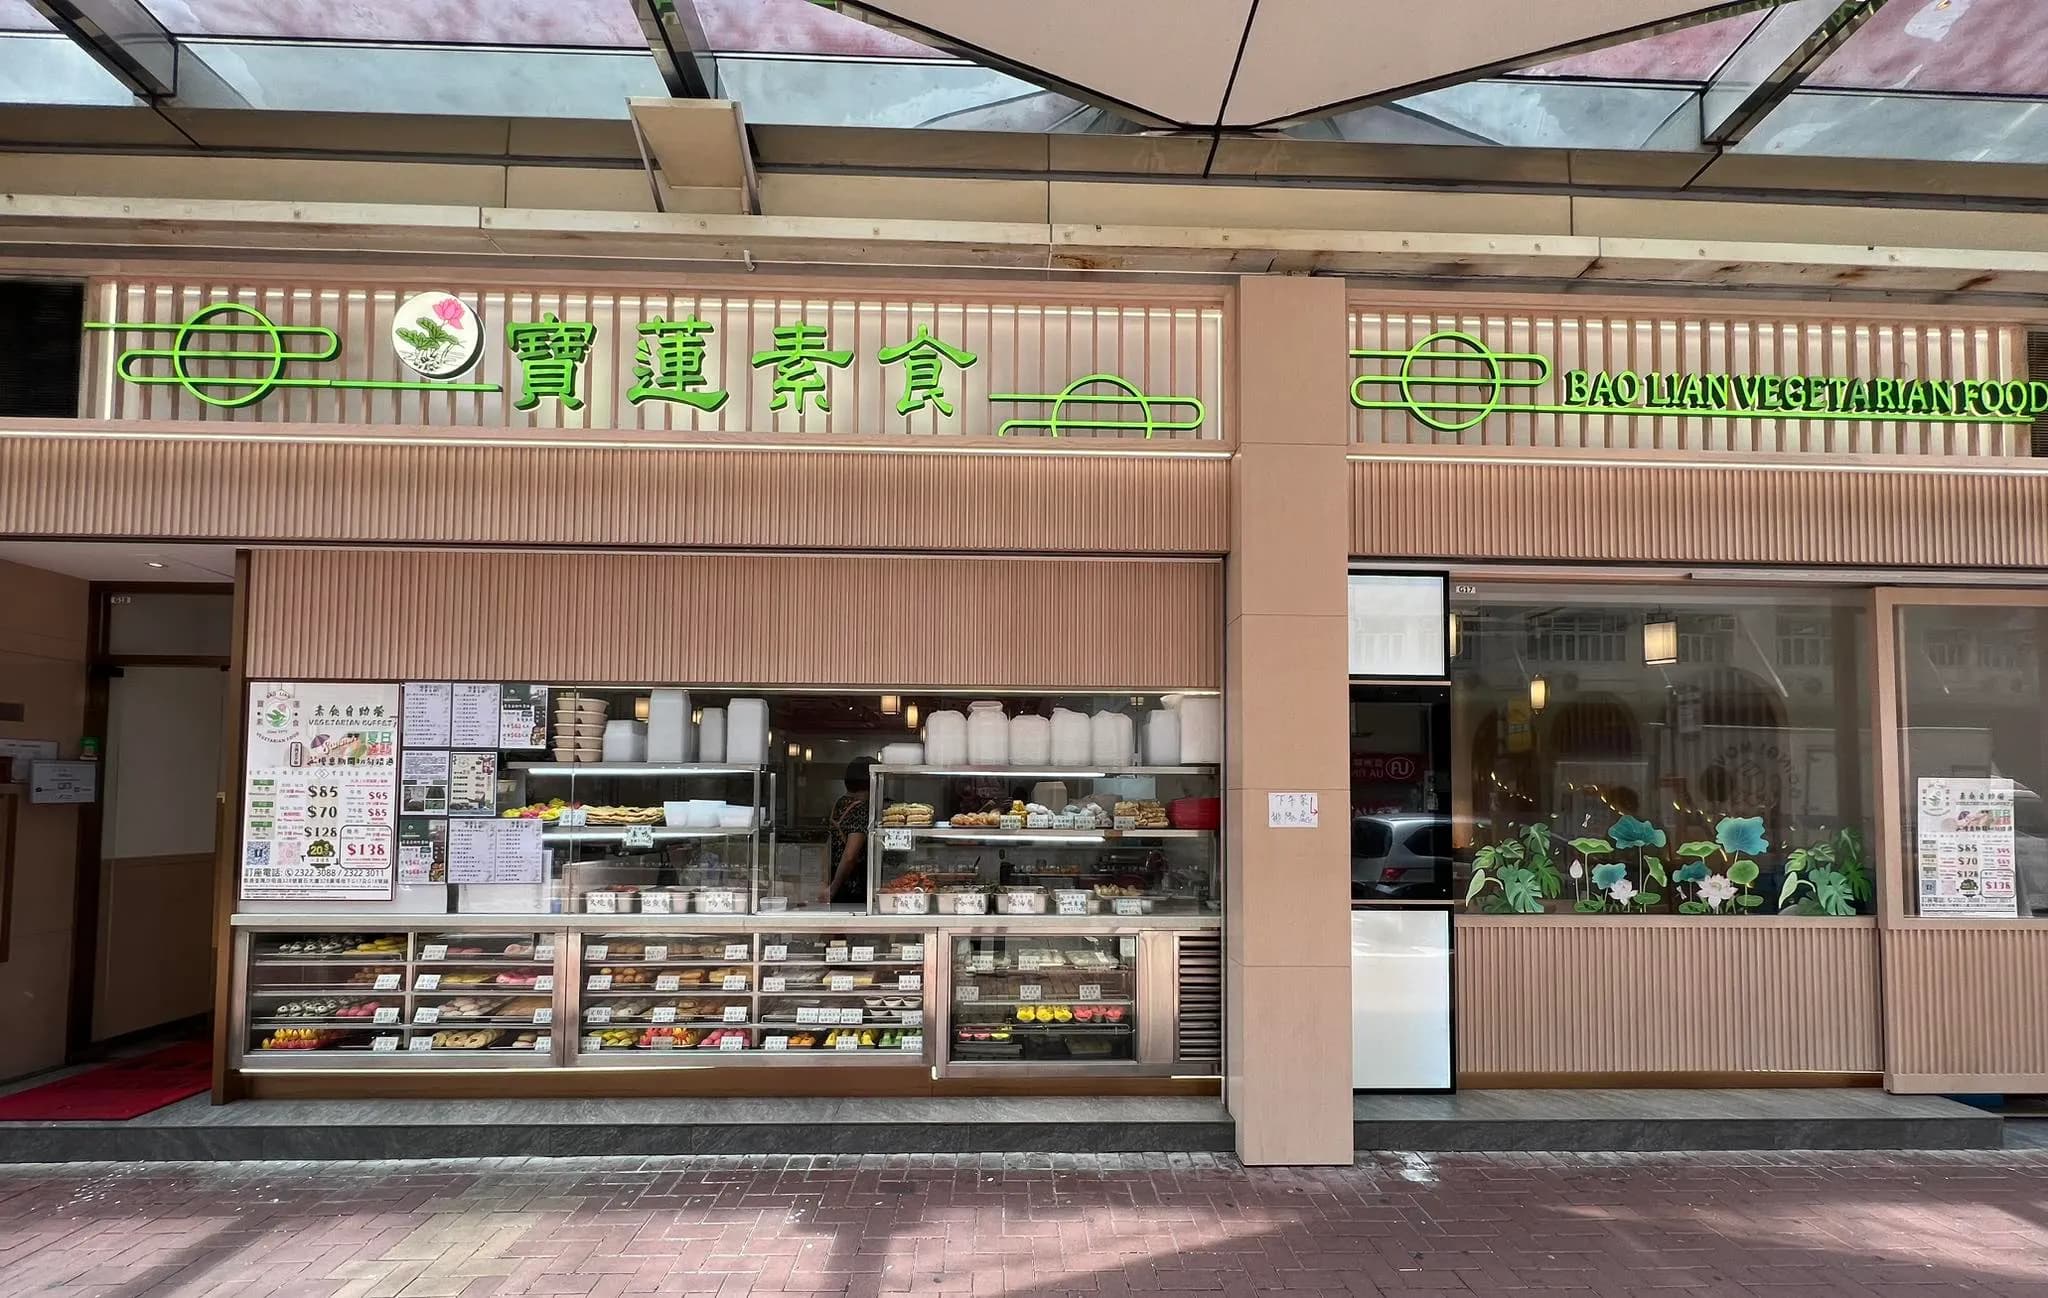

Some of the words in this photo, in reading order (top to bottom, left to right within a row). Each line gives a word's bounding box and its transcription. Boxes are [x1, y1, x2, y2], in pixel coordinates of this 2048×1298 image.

[506, 312, 977, 416] 寶蓮素食
[1565, 369, 1641, 406] BAO
[1645, 371, 1729, 409] LIAN
[1732, 374, 1951, 414] VEGETARIAN
[1952, 379, 2048, 417] FOOD
[308, 785, 338, 798] $85
[308, 805, 338, 818] $70
[304, 826, 338, 838] $128
[347, 843, 385, 856] $138
[1958, 844, 1978, 852] $85
[1958, 856, 1978, 866] $70
[295, 868, 314, 877] 2322
[344, 868, 364, 877] 2322
